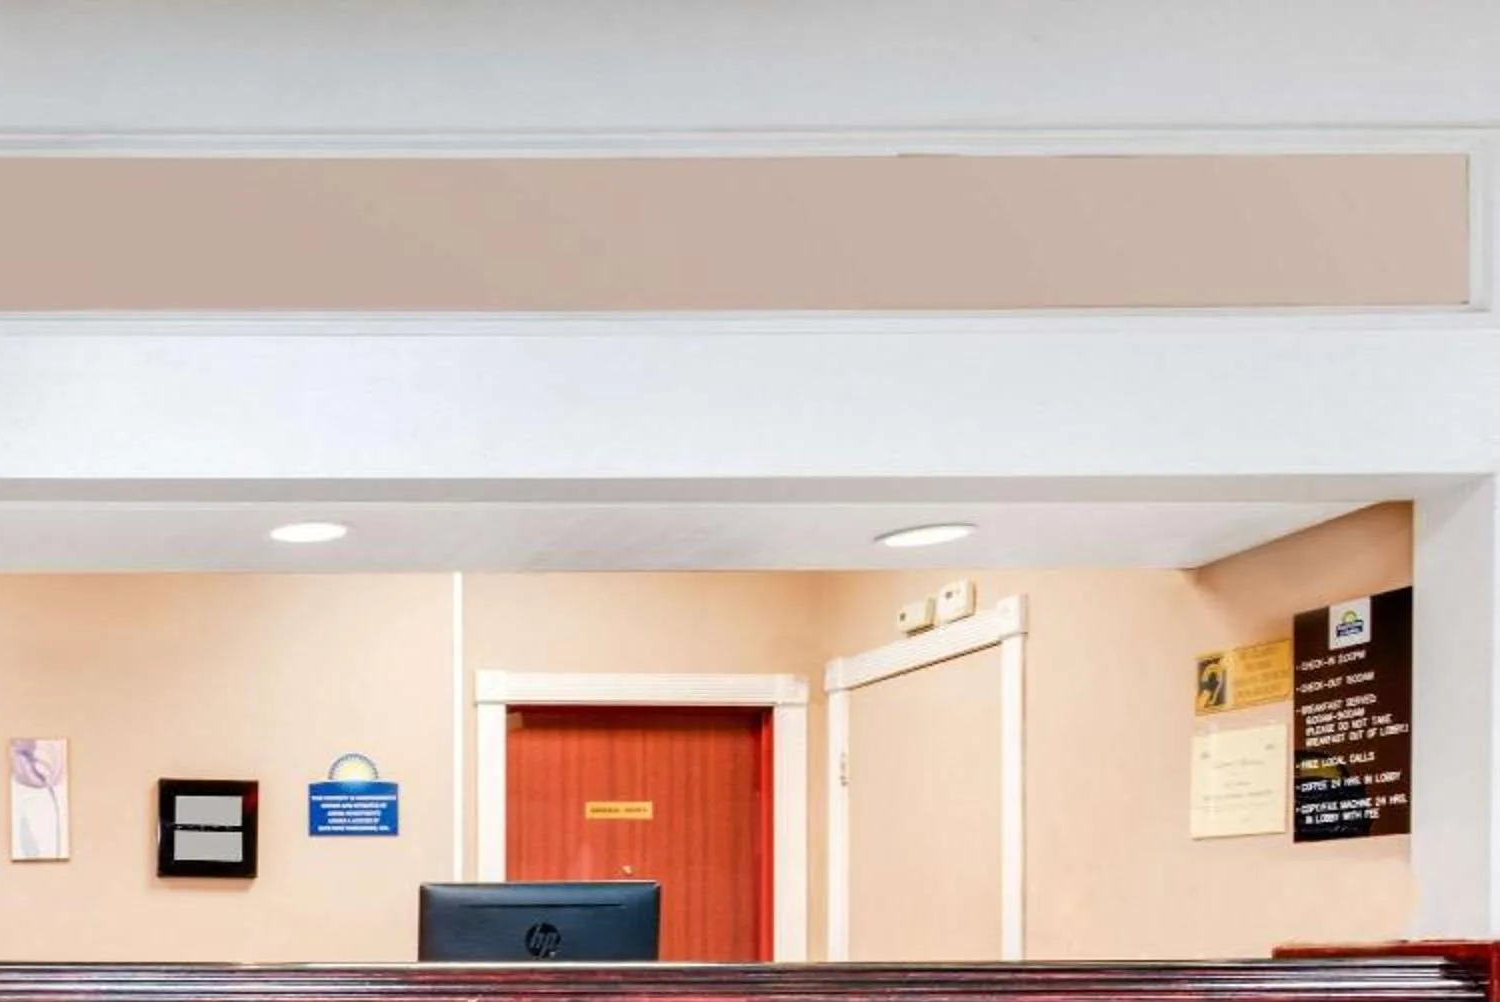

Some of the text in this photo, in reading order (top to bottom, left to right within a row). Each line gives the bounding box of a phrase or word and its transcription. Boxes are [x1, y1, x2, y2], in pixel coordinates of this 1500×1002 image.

[1338, 721, 1349, 731] DO
[1351, 717, 1368, 729] NOT
[1348, 729, 1364, 741] OUT
[1366, 727, 1378, 739] OF
[1321, 755, 1347, 768] LOCAL
[1350, 751, 1375, 763] CALLS
[1364, 774, 1373, 785] IN
[1375, 770, 1402, 783] LOBBY
[1315, 812, 1339, 824] LOBBY
